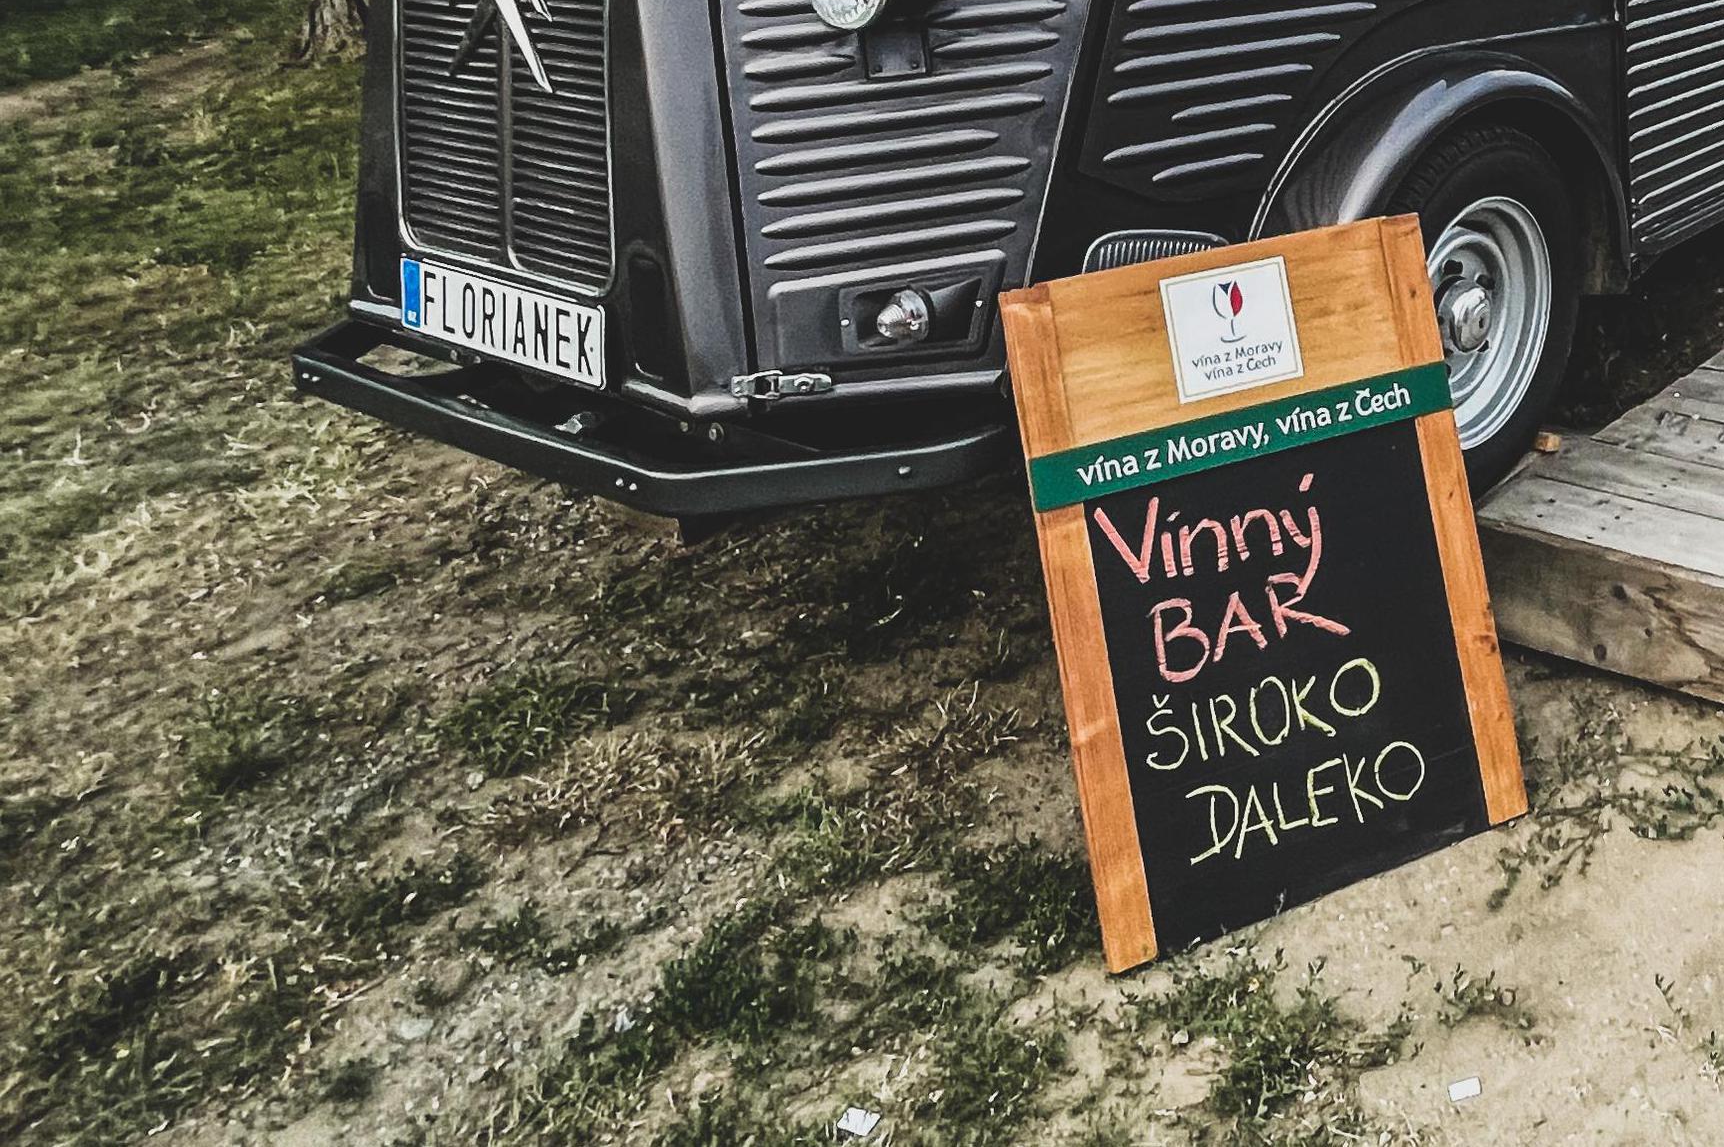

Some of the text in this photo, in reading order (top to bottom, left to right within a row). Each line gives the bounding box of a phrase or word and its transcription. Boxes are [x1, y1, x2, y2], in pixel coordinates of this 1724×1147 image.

[423, 270, 593, 377] FLORIANEK
[1191, 340, 1283, 369] vína z Moravy
[1204, 365, 1234, 381] vína
[1237, 363, 1245, 374] z
[1076, 382, 1412, 486] vína z Moravy, vína z Čech
[1146, 573, 1350, 684] BAR
[1145, 657, 1382, 772] ŠIROKO
[1186, 740, 1426, 865] DALEKO
